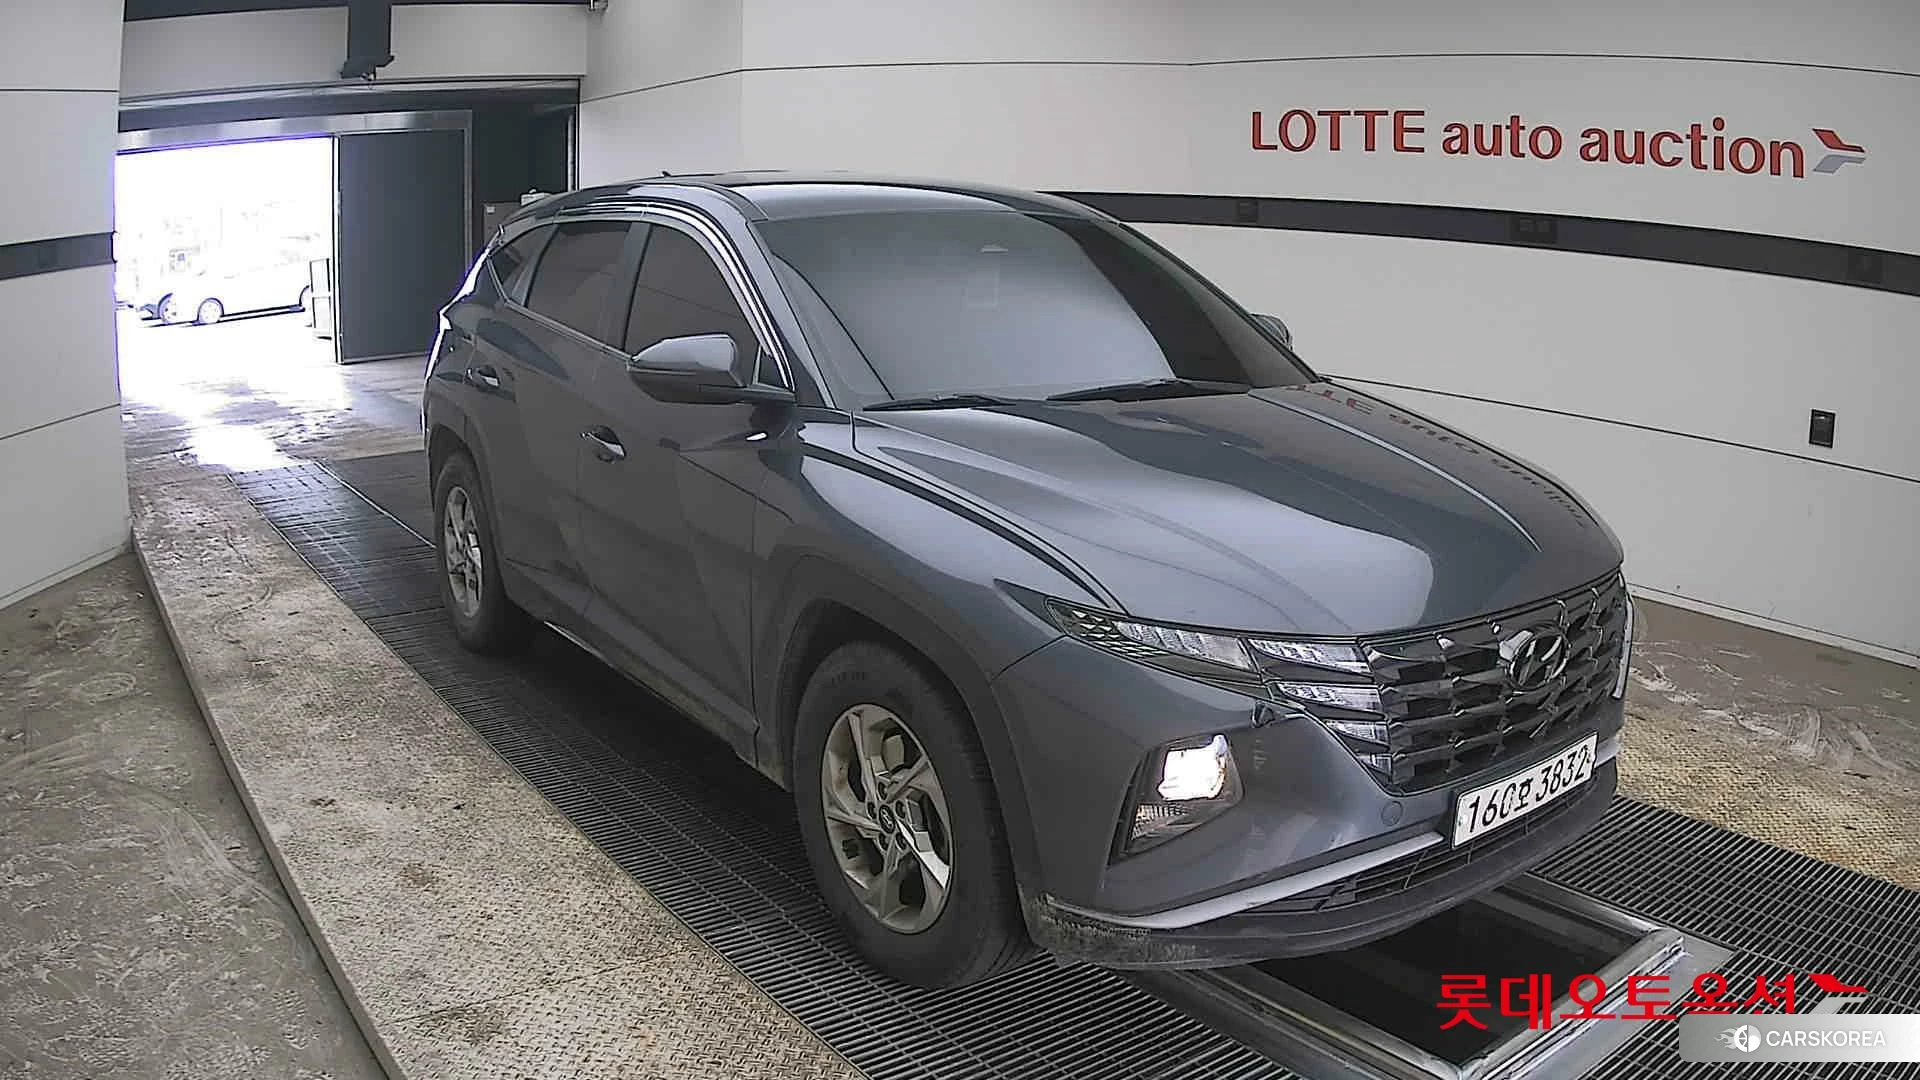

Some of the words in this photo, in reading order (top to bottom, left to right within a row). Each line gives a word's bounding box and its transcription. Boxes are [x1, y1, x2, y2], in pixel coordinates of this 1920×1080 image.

[1251, 110, 1425, 153] LOTTE
[1441, 115, 1563, 160] auto
[1579, 117, 1806, 178] auction
